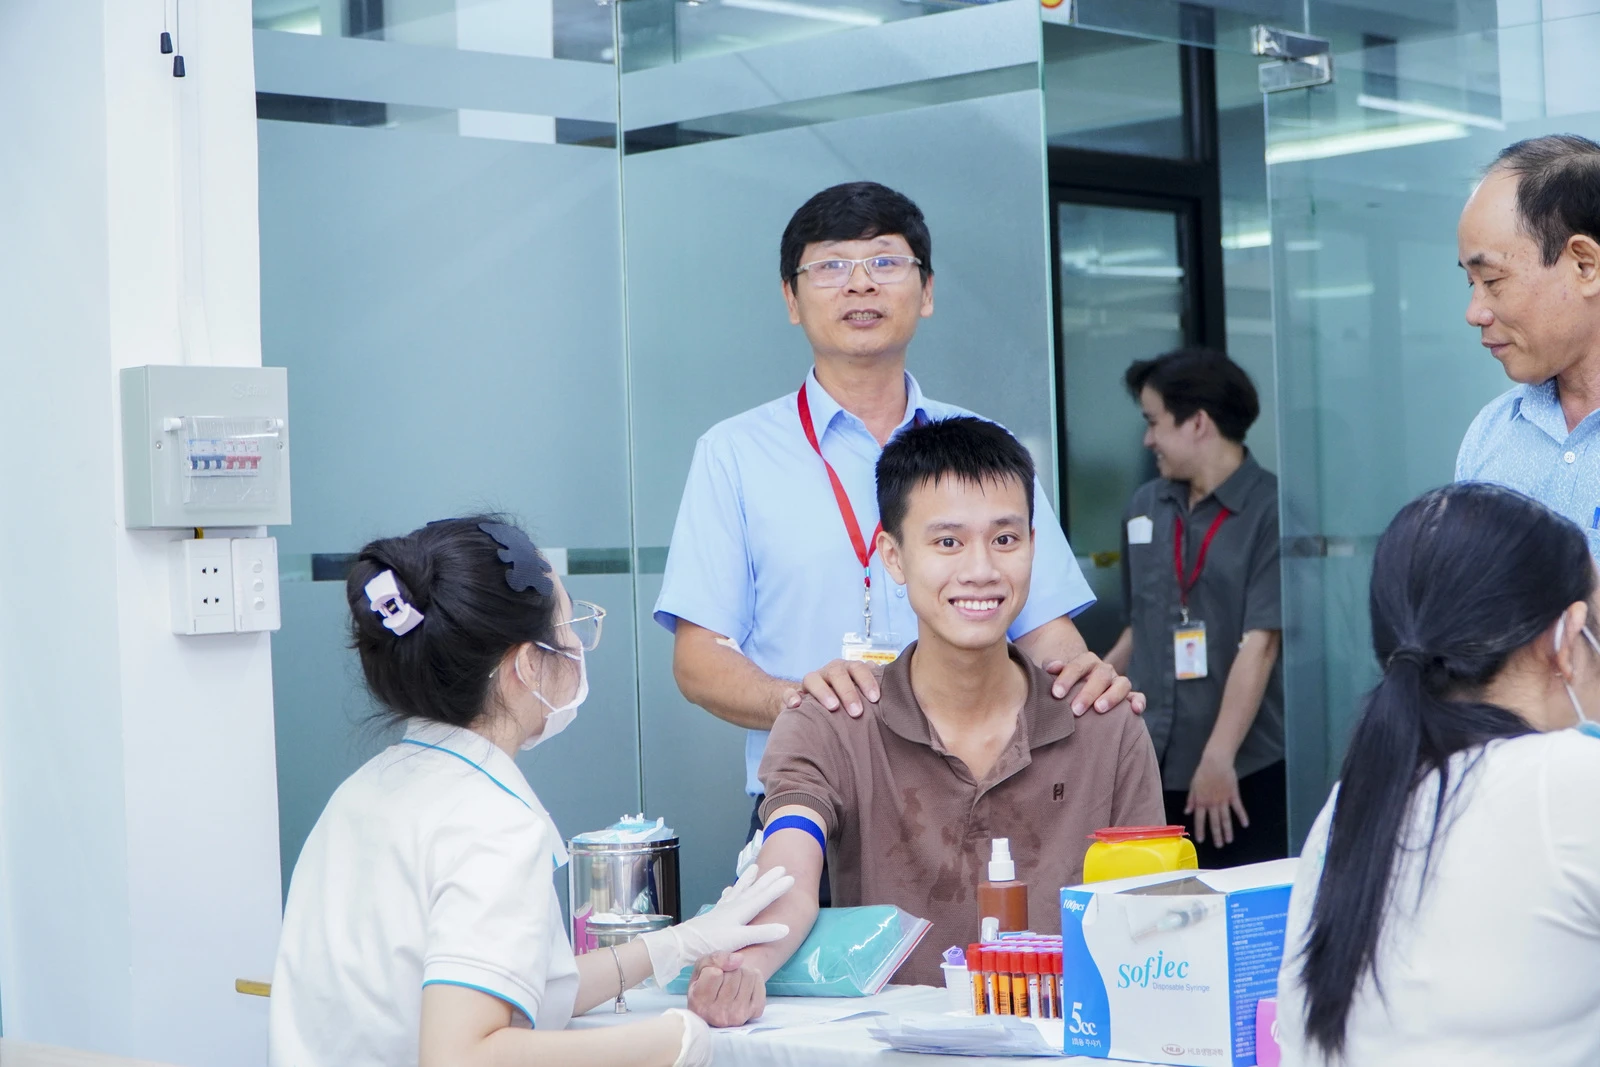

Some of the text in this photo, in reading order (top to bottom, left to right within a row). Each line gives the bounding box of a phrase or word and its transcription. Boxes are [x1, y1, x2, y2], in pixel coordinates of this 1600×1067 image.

[1063, 899, 1085, 913] 100pcs
[1117, 950, 1189, 989] Sofjec
[1152, 982, 1210, 993] Disposable Syringe
[1069, 1001, 1097, 1036] 5cc
